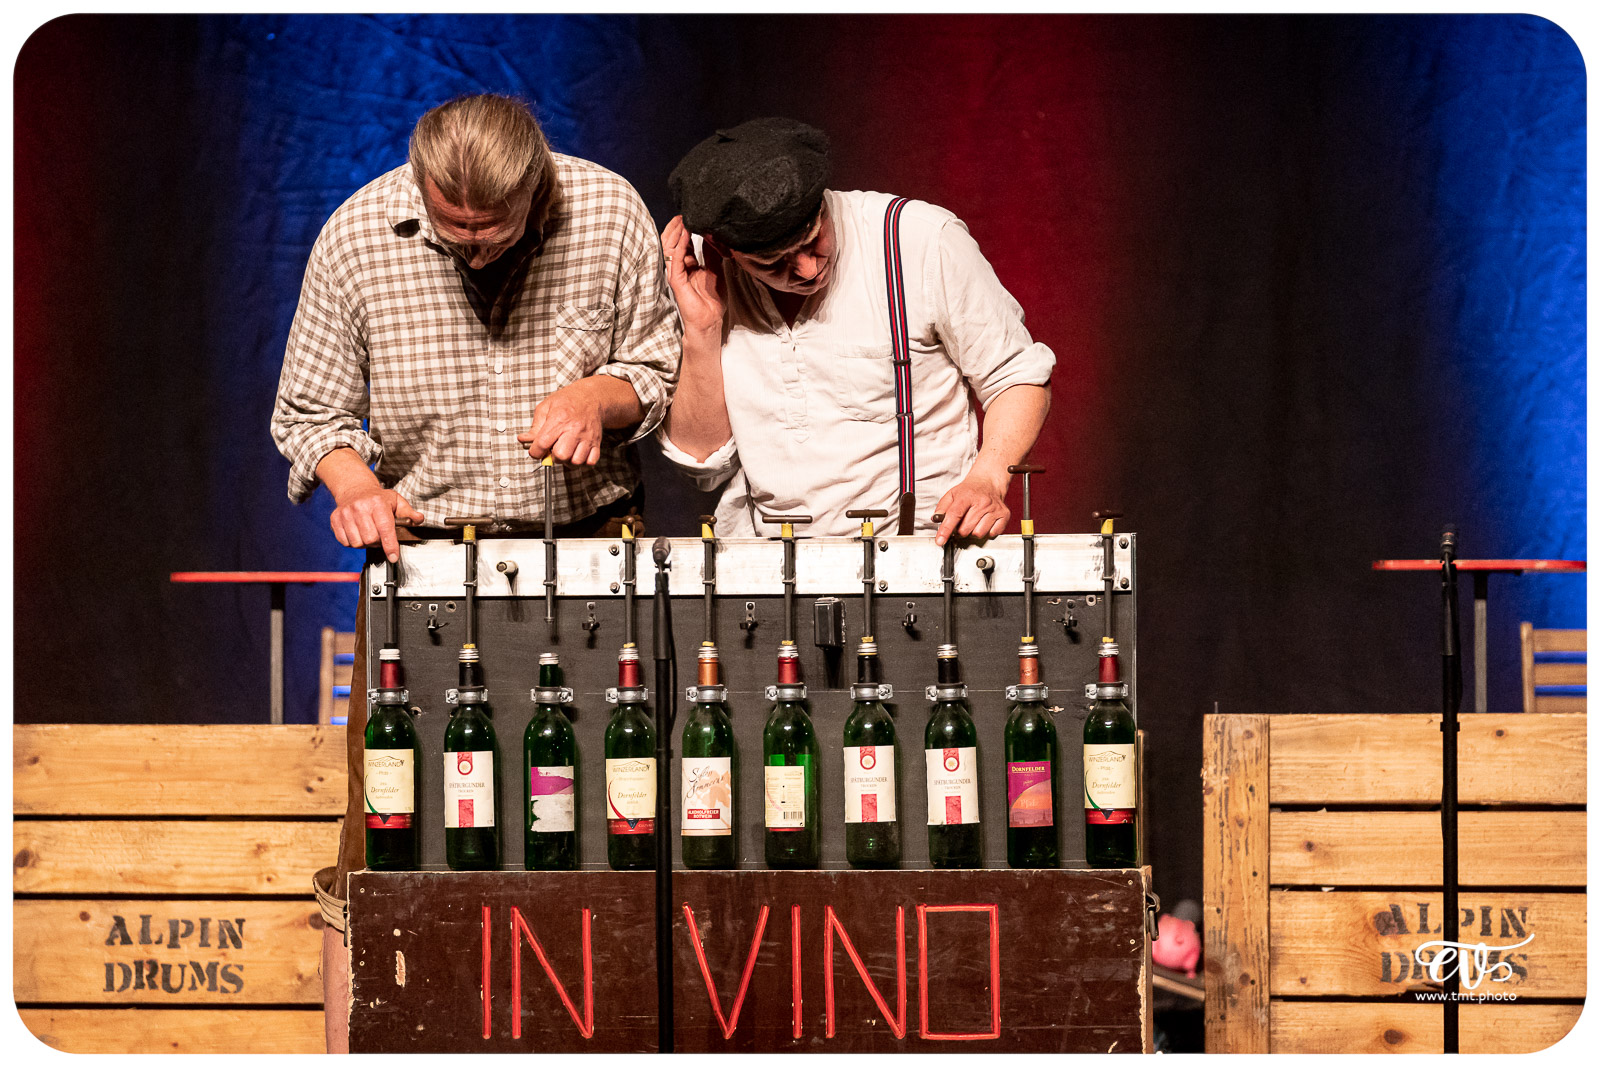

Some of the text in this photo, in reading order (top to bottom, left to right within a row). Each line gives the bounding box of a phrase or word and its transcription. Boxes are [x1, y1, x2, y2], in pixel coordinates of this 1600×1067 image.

[370, 786, 399, 796] Dornfelder
[617, 791, 647, 800] Dornfelder
[1091, 781, 1121, 791] Dornfelder
[105, 914, 246, 949] ALPIN
[103, 959, 244, 994] DRUMS
[482, 902, 1000, 1040] IN VINO
[1380, 950, 1529, 985] DRMS
